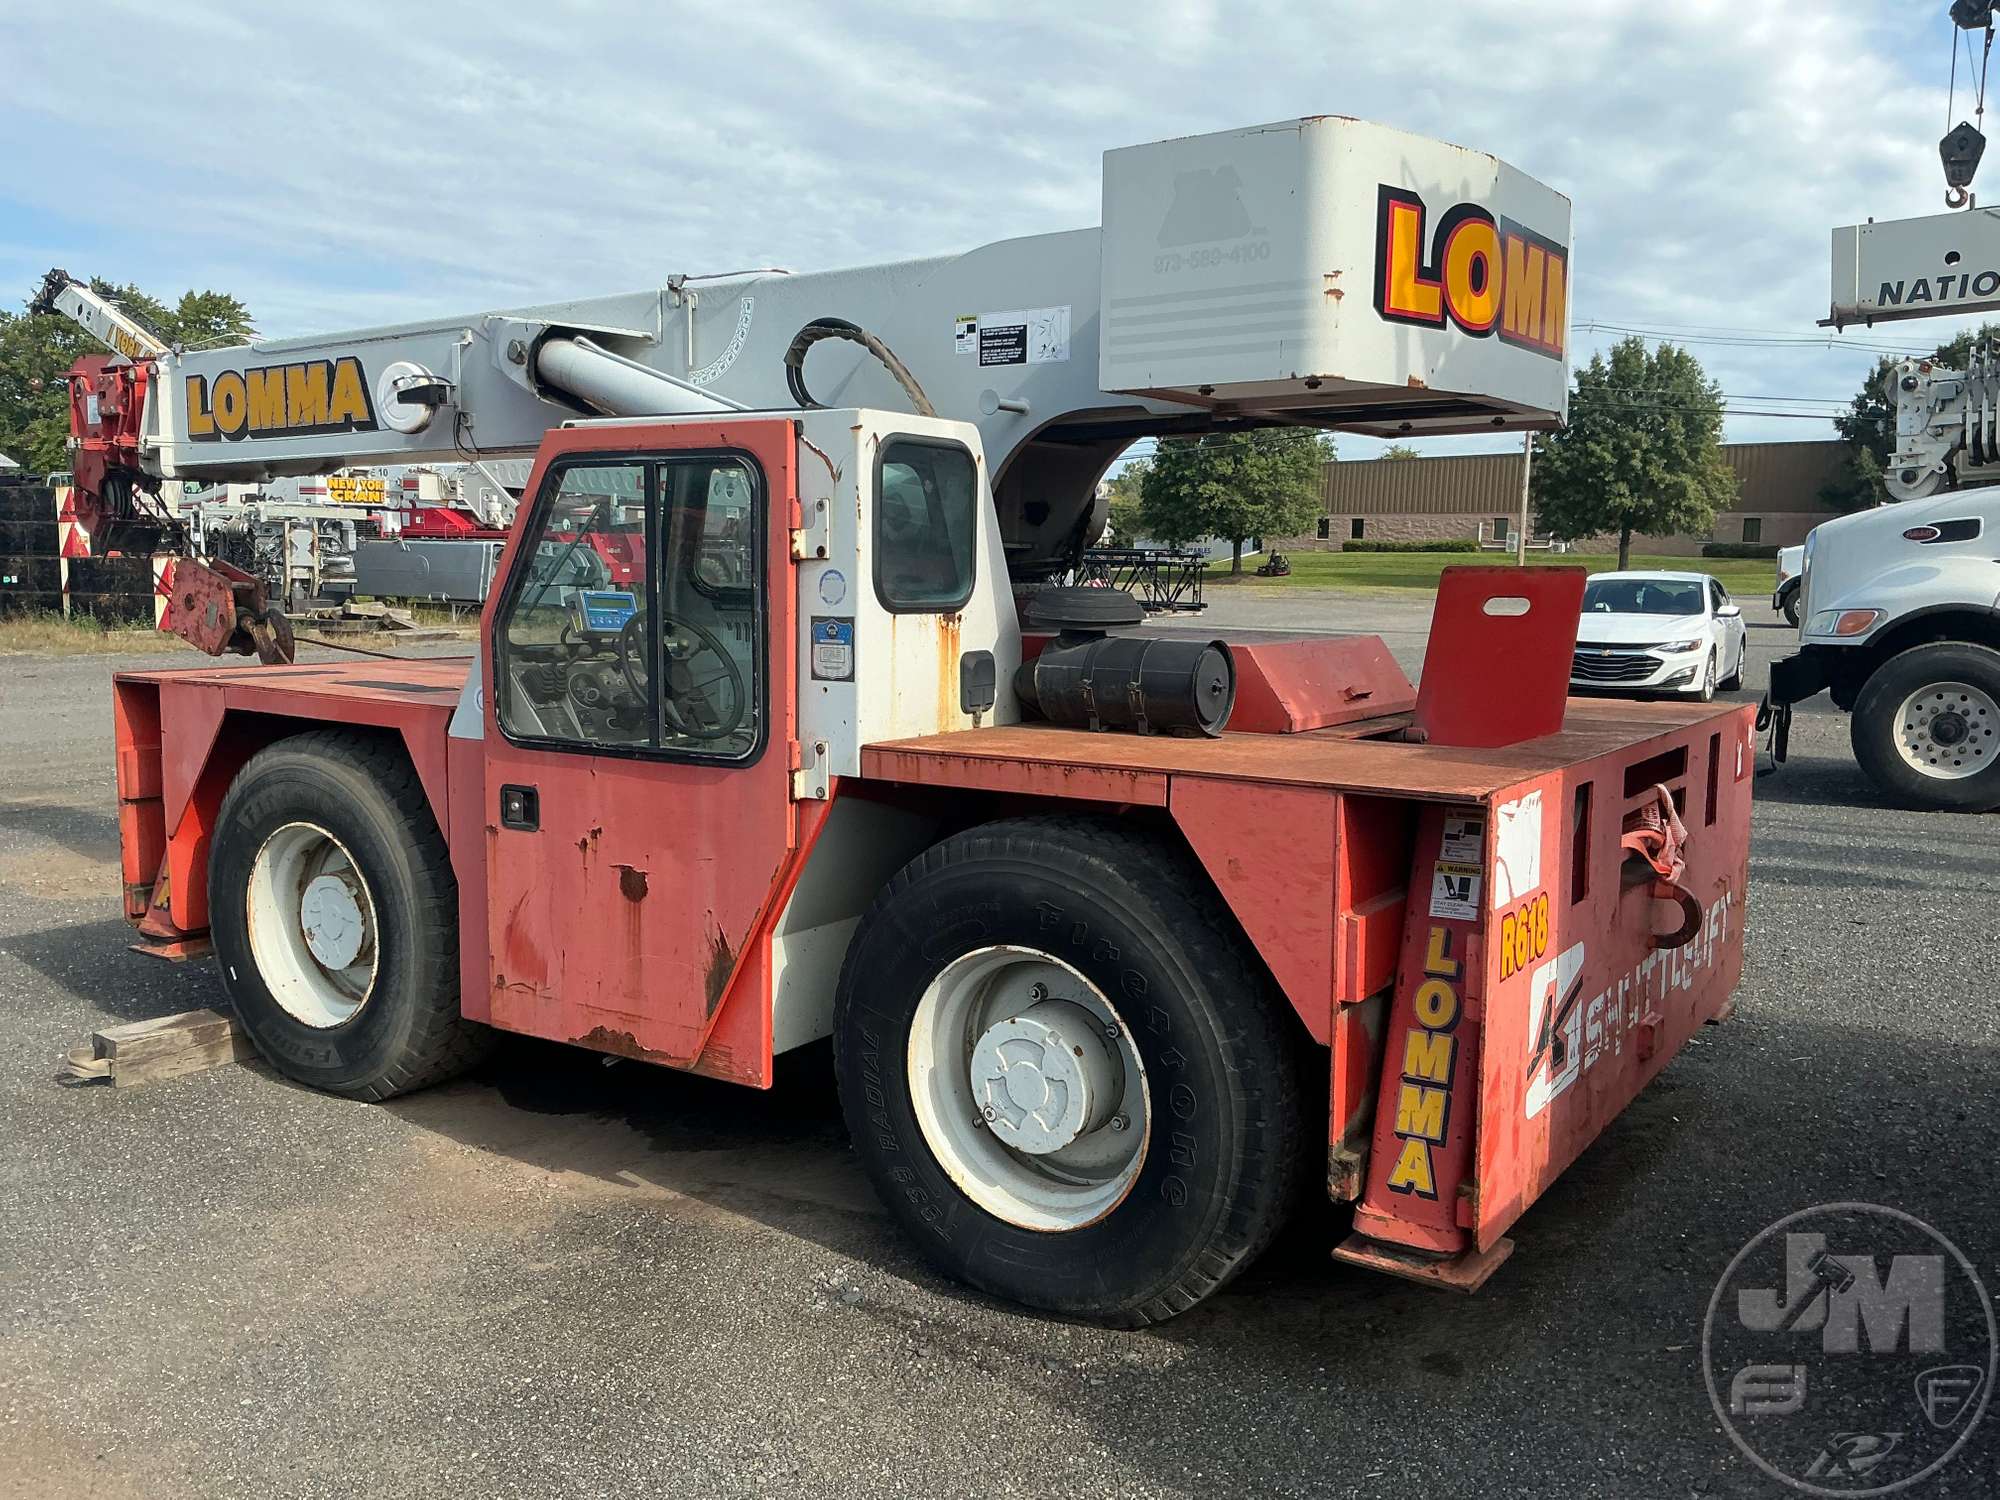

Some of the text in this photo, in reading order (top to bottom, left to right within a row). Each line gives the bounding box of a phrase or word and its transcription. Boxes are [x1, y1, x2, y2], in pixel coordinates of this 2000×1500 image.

[1878, 271, 2000, 306] NATIO
[186, 356, 379, 441] LOMMA
[328, 478, 356, 491] NEW
[1499, 891, 1548, 983] R618
[862, 1031, 900, 1152] RADIAL
[1033, 901, 1198, 1207] Firestone
[1387, 927, 1463, 1201] LOMMA
